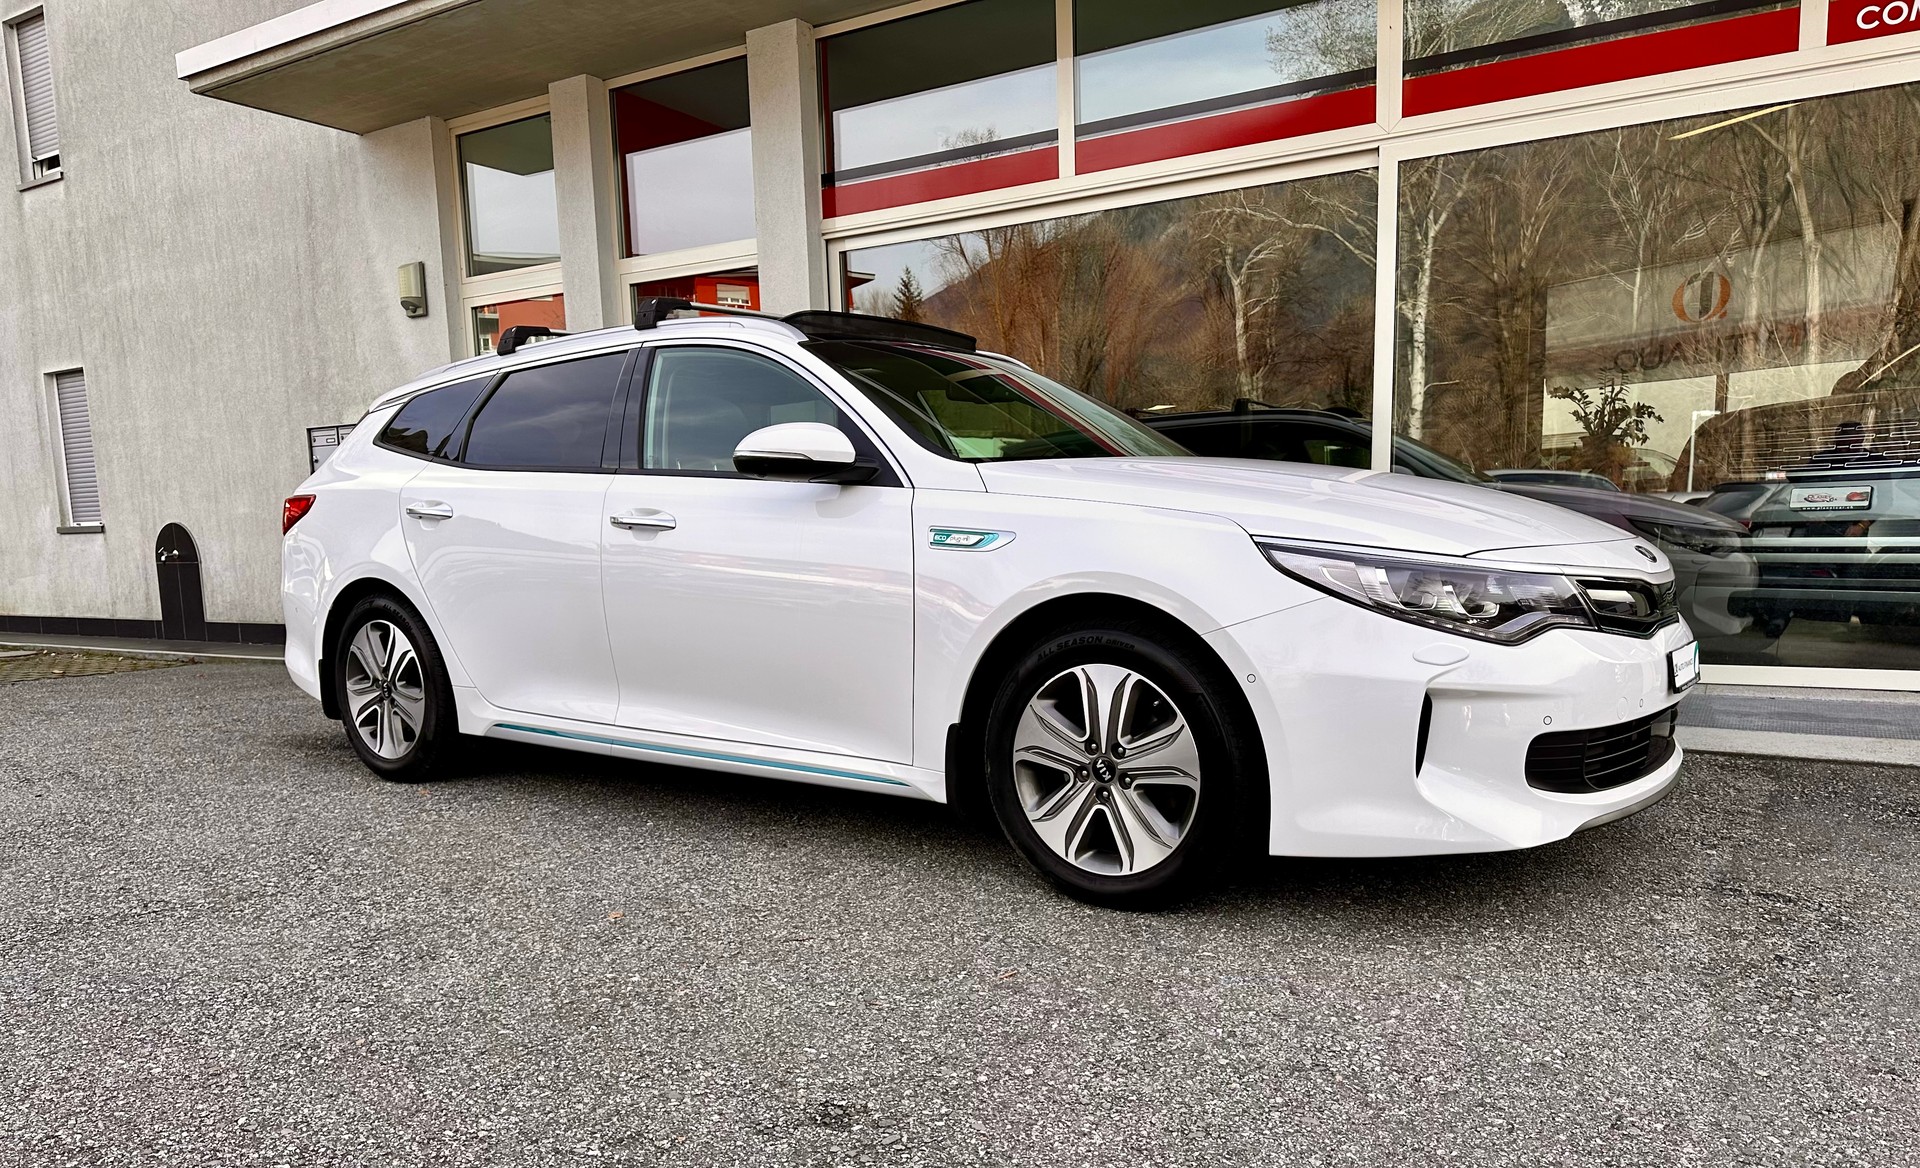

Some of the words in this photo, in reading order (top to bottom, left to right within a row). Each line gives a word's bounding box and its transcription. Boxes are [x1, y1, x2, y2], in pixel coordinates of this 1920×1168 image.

[1036, 647, 1055, 663] ALL
[1056, 636, 1103, 652] SEASON
[1105, 638, 1136, 650] DRIVER
[1096, 759, 1112, 781] KIA
